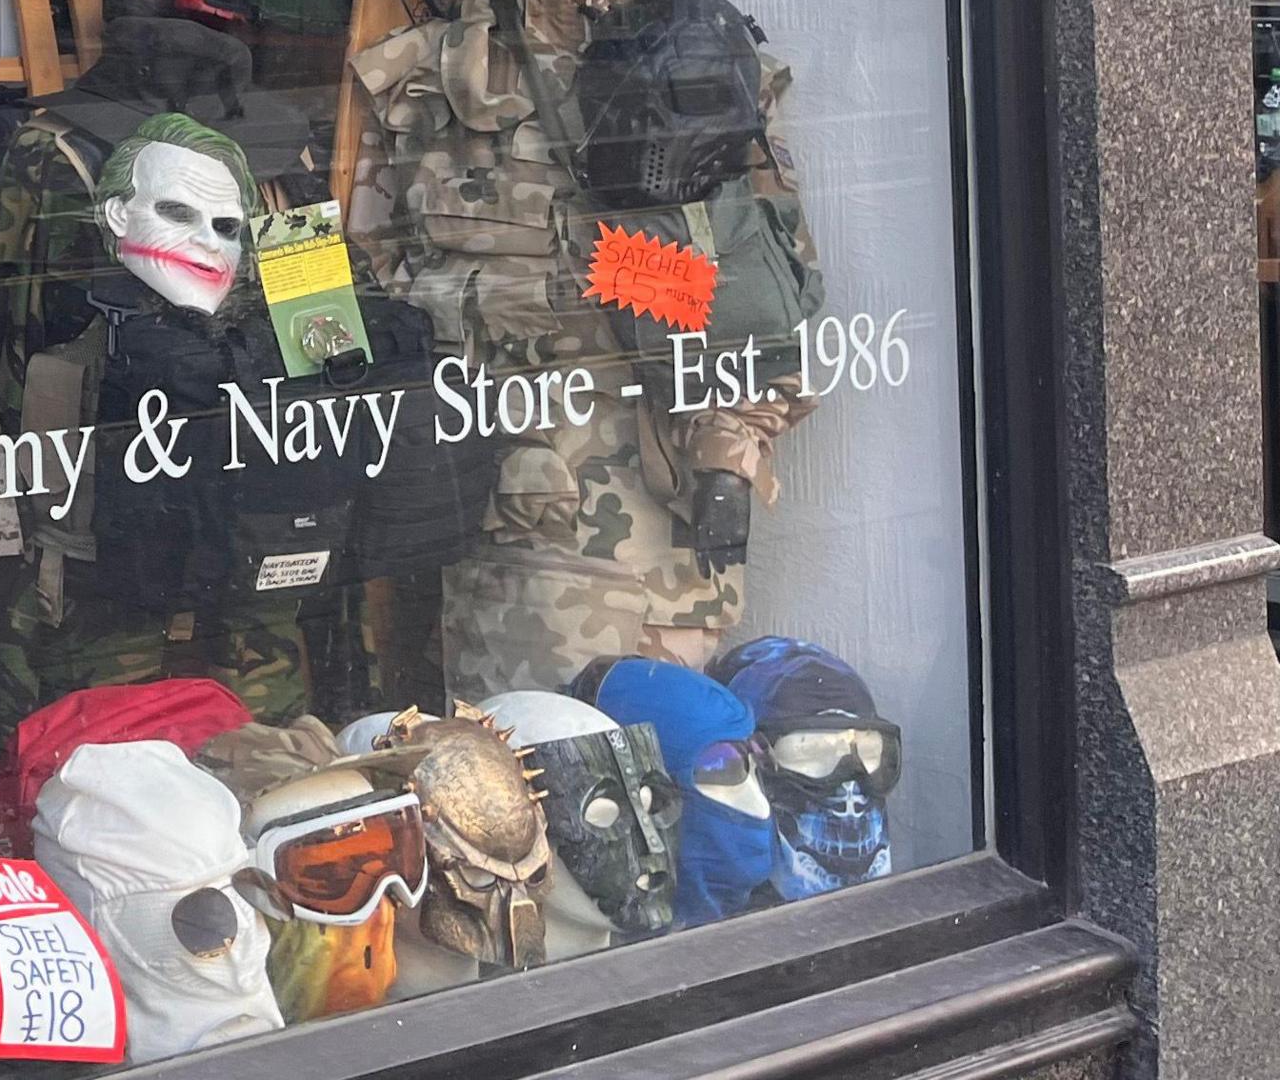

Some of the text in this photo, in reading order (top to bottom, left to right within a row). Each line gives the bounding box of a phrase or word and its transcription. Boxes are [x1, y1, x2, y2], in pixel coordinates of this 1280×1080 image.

[605, 240, 691, 282] SATCHEL
[122, 388, 192, 484] &
[222, 376, 405, 479] Navy
[434, 356, 598, 445] Store
[621, 382, 643, 397] -
[669, 329, 776, 414] Est.
[794, 308, 911, 397] 1986
[10, 958, 95, 991] SAFETY
[20, 989, 85, 1042] £18
